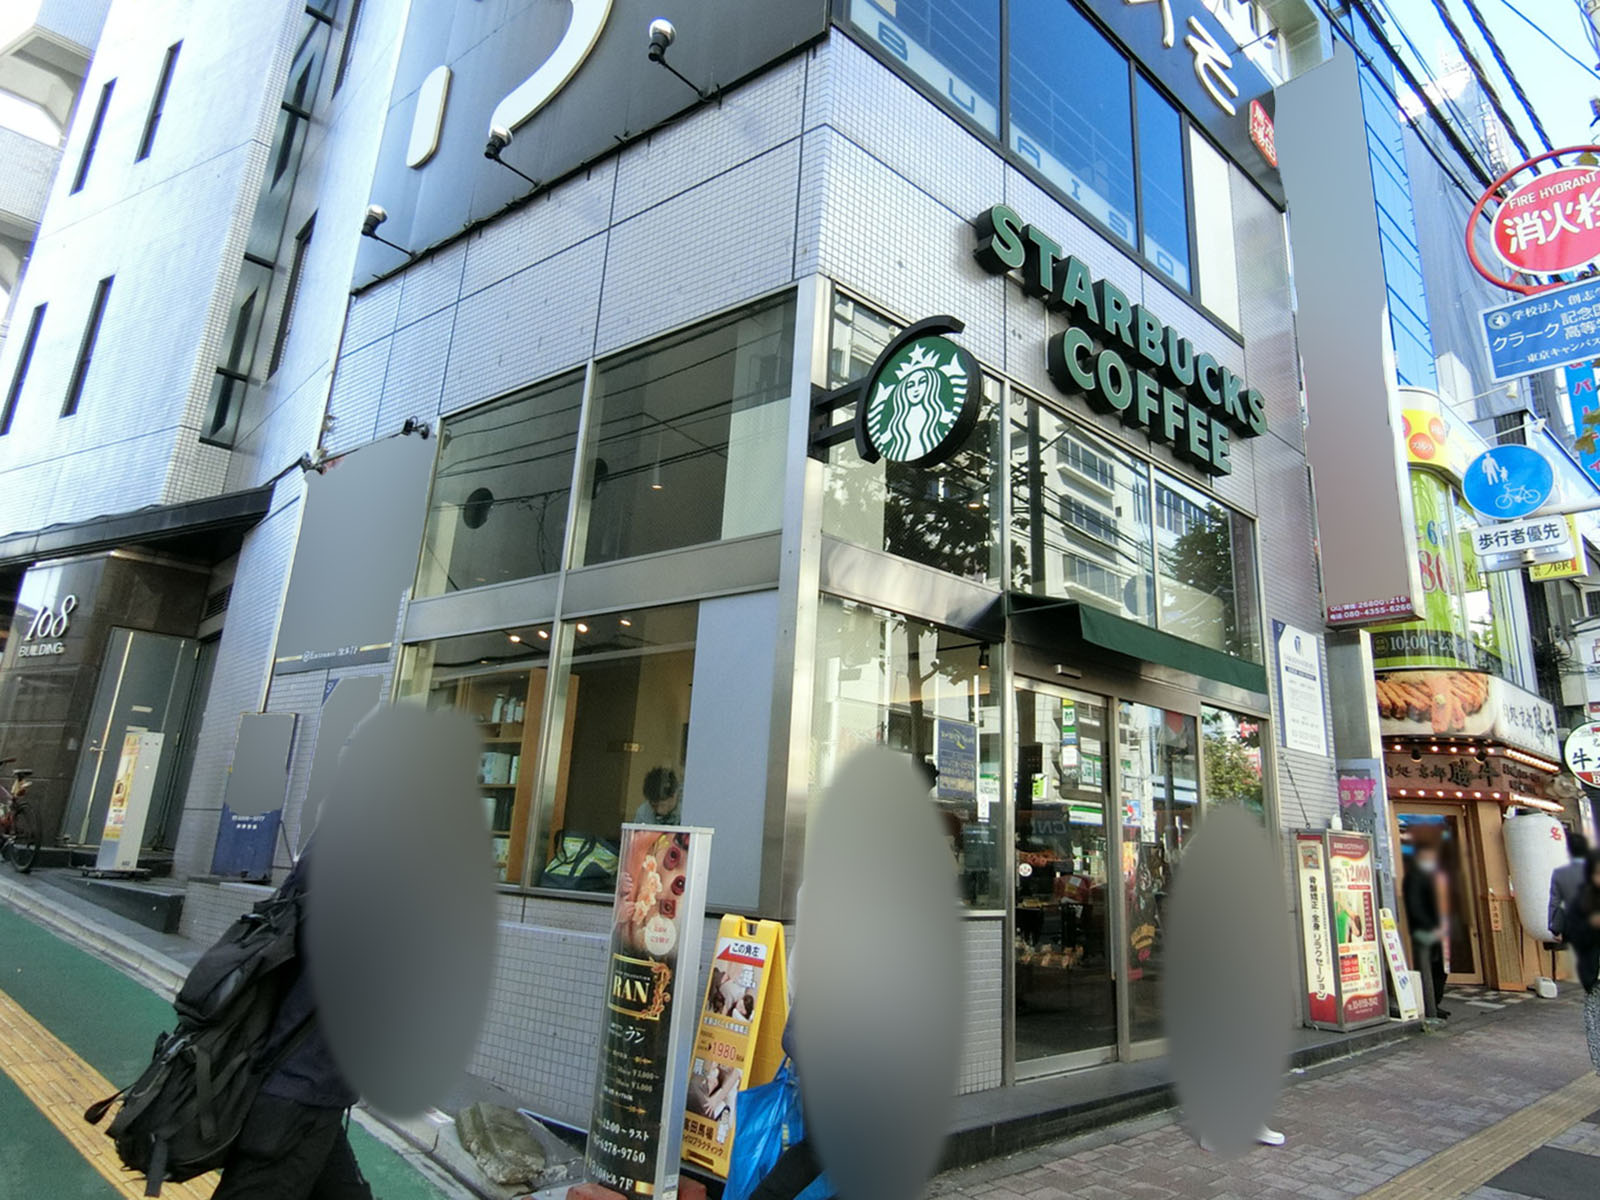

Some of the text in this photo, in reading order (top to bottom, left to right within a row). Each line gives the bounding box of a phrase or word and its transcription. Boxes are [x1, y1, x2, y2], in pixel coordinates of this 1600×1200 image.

[1509, 171, 1598, 210] FIRE HYDRANT
[1511, 287, 1600, 320] 学校法人 創志
[990, 202, 1268, 436] STARBUCKS
[1493, 323, 1560, 352] クラーク
[1063, 326, 1232, 476] COFFEE
[1478, 522, 1560, 550] 歩行者優先
[24, 594, 76, 641] 108
[18, 642, 64, 657] BUILDING
[612, 975, 650, 1003] RAN
[624, 1026, 646, 1044] ラン
[712, 1041, 737, 1061] 1980
[618, 1176, 635, 1191] 7F
